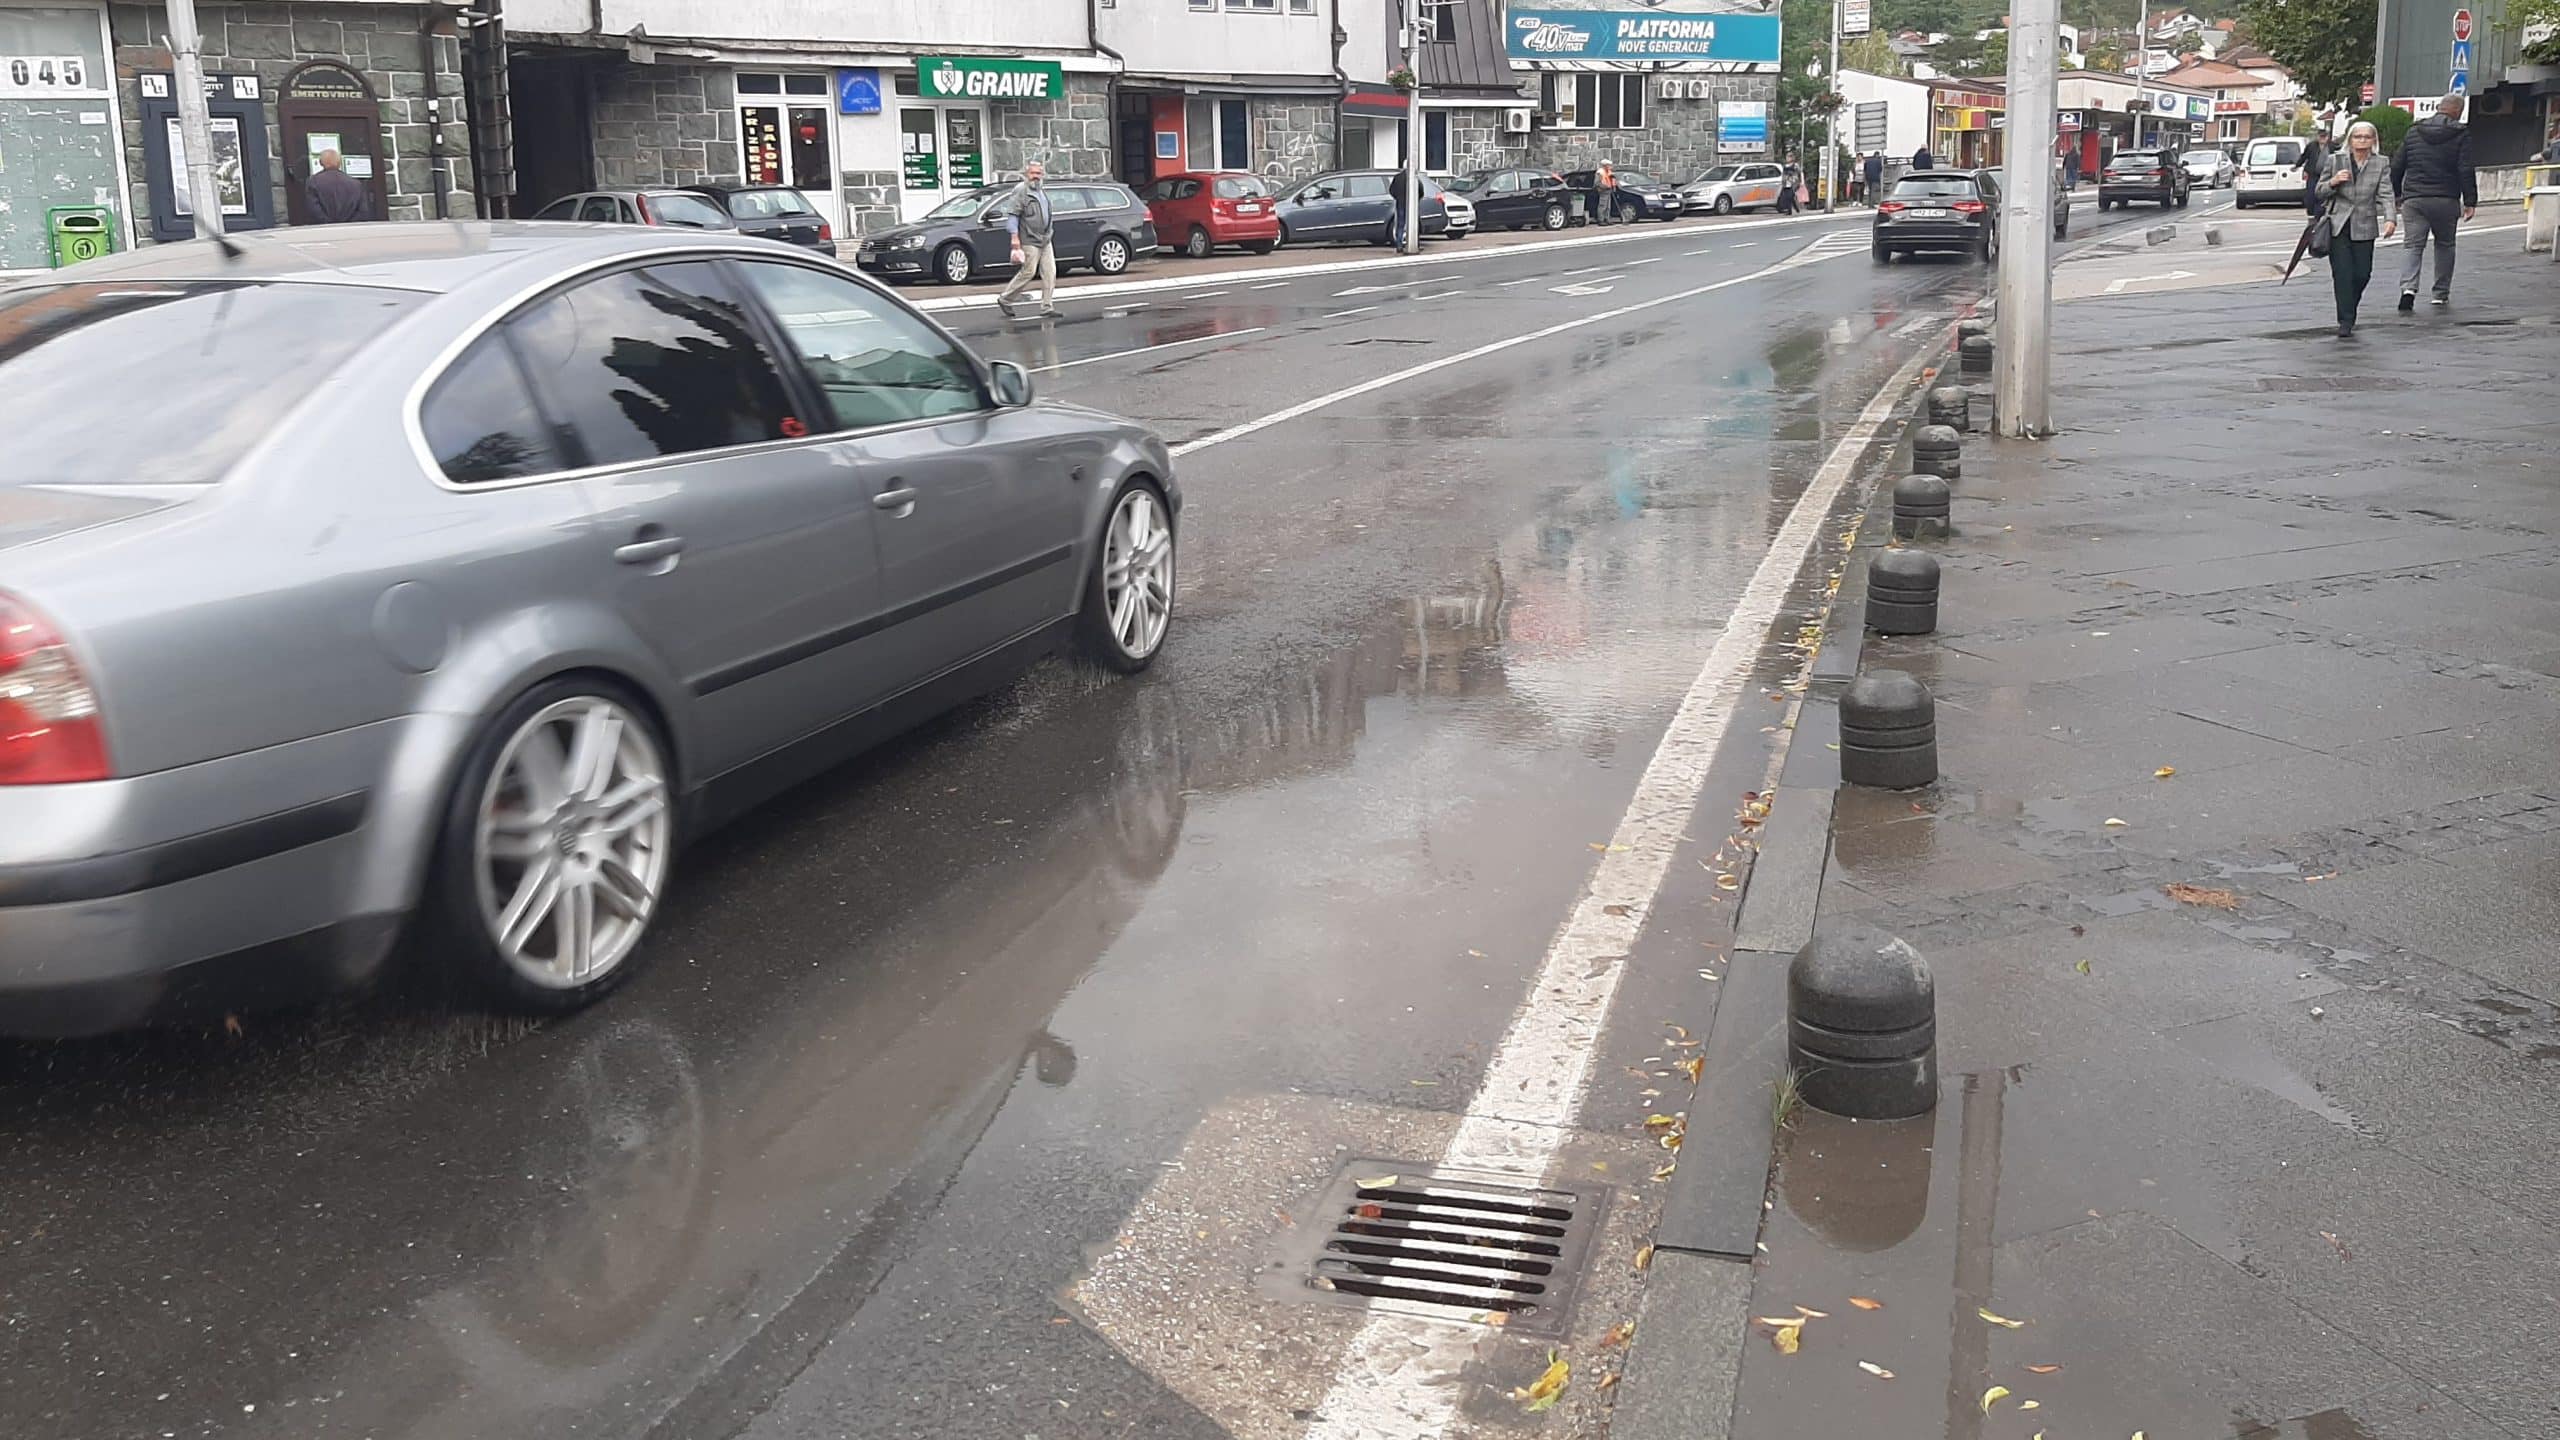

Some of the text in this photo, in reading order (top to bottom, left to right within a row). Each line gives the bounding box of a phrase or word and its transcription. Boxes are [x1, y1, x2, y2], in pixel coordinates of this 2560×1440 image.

[1617, 19, 1715, 39] PLATFORMA
[2455, 19, 2471, 33] STOP
[1617, 40, 1710, 53] NOVE GENERACIJE
[966, 71, 1048, 97] GRAWE
[763, 124, 778, 169] SALON
